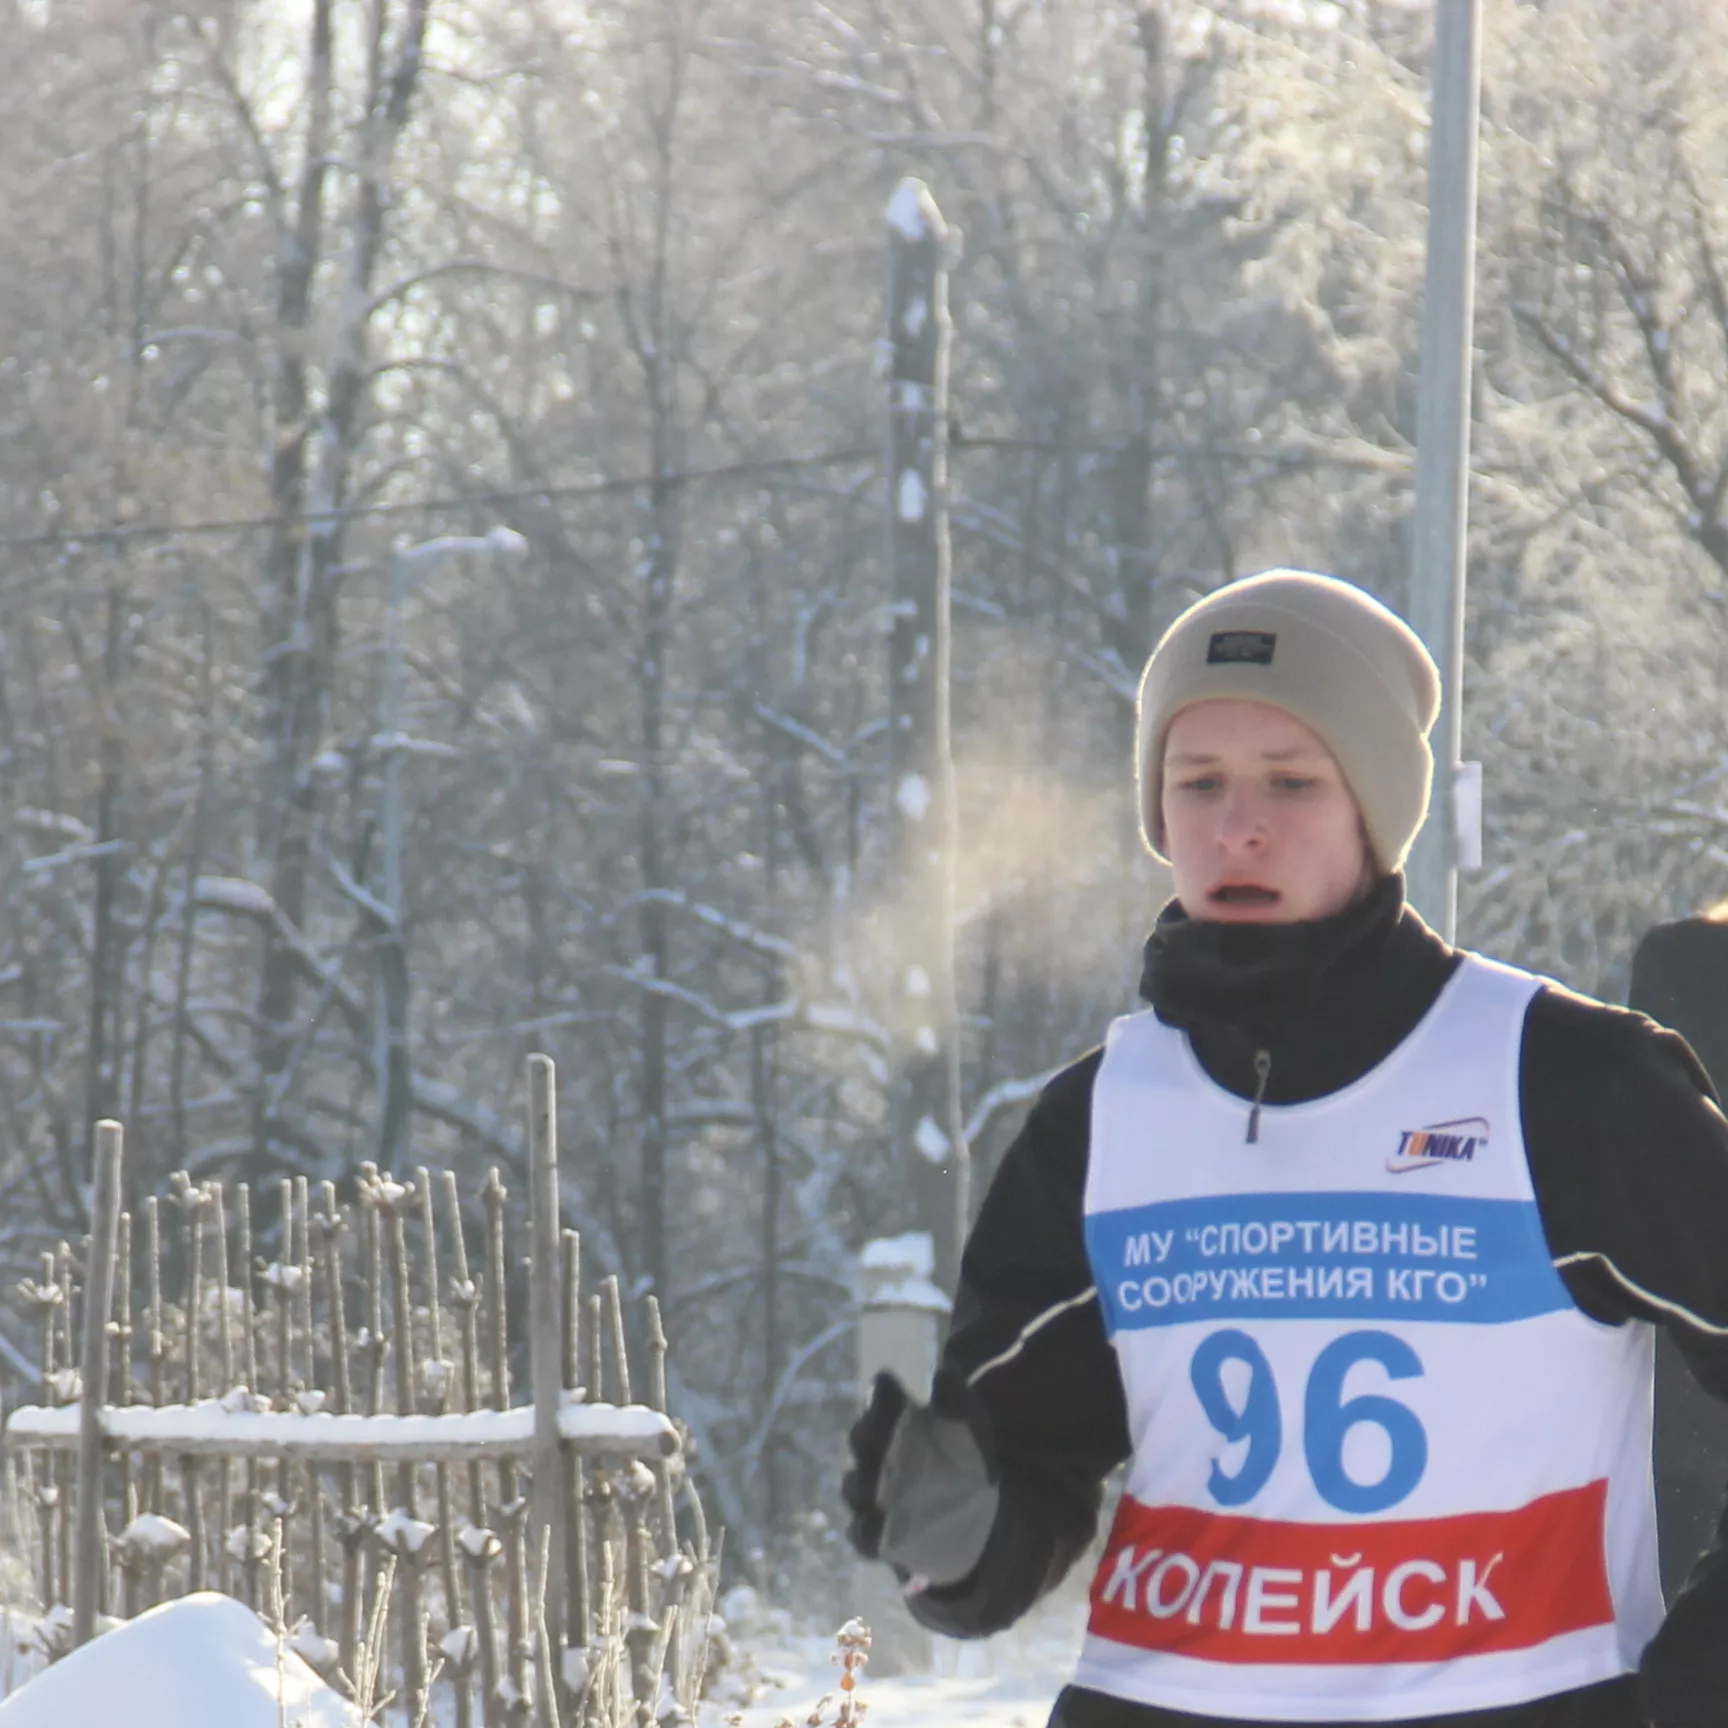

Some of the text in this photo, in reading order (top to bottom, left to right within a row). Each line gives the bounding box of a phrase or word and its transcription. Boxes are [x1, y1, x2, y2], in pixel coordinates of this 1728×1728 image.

[1124, 1230, 1174, 1267] МУ
[1117, 1267, 1373, 1312] СООРУЖЕНИЯ
[1189, 1328, 1429, 1515] 96
[1101, 1545, 1507, 1636] КОПЕЙСК
